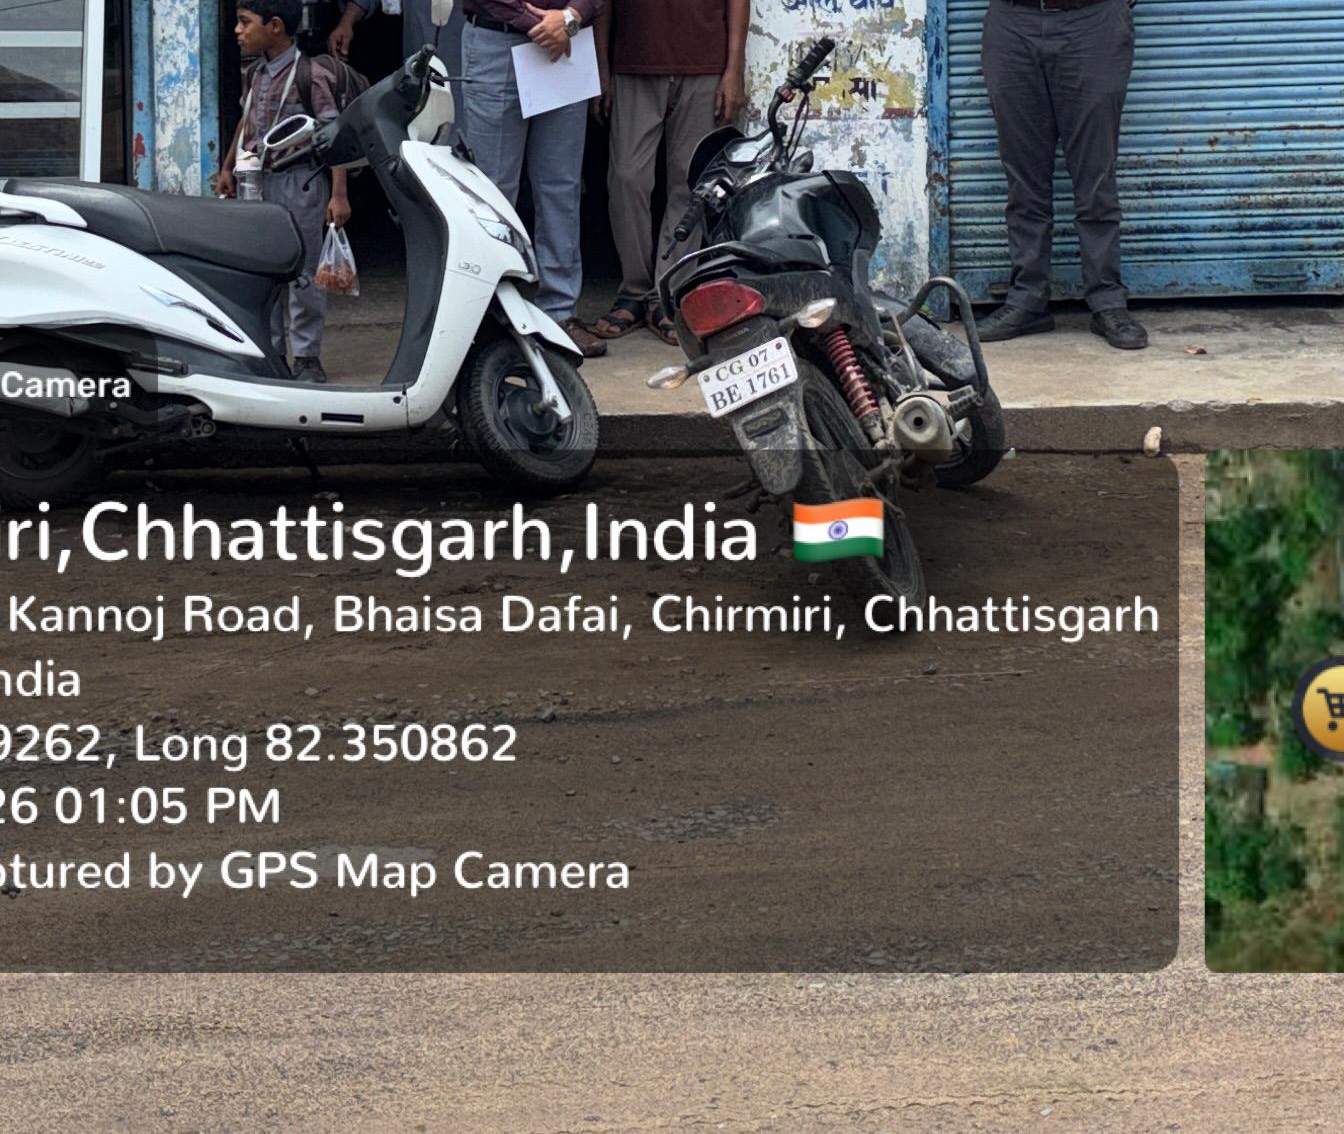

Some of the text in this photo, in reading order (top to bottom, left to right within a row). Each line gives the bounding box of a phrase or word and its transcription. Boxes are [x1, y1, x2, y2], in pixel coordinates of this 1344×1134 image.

[715, 349, 769, 383] CG 07
[709, 362, 793, 413] BE 1761
